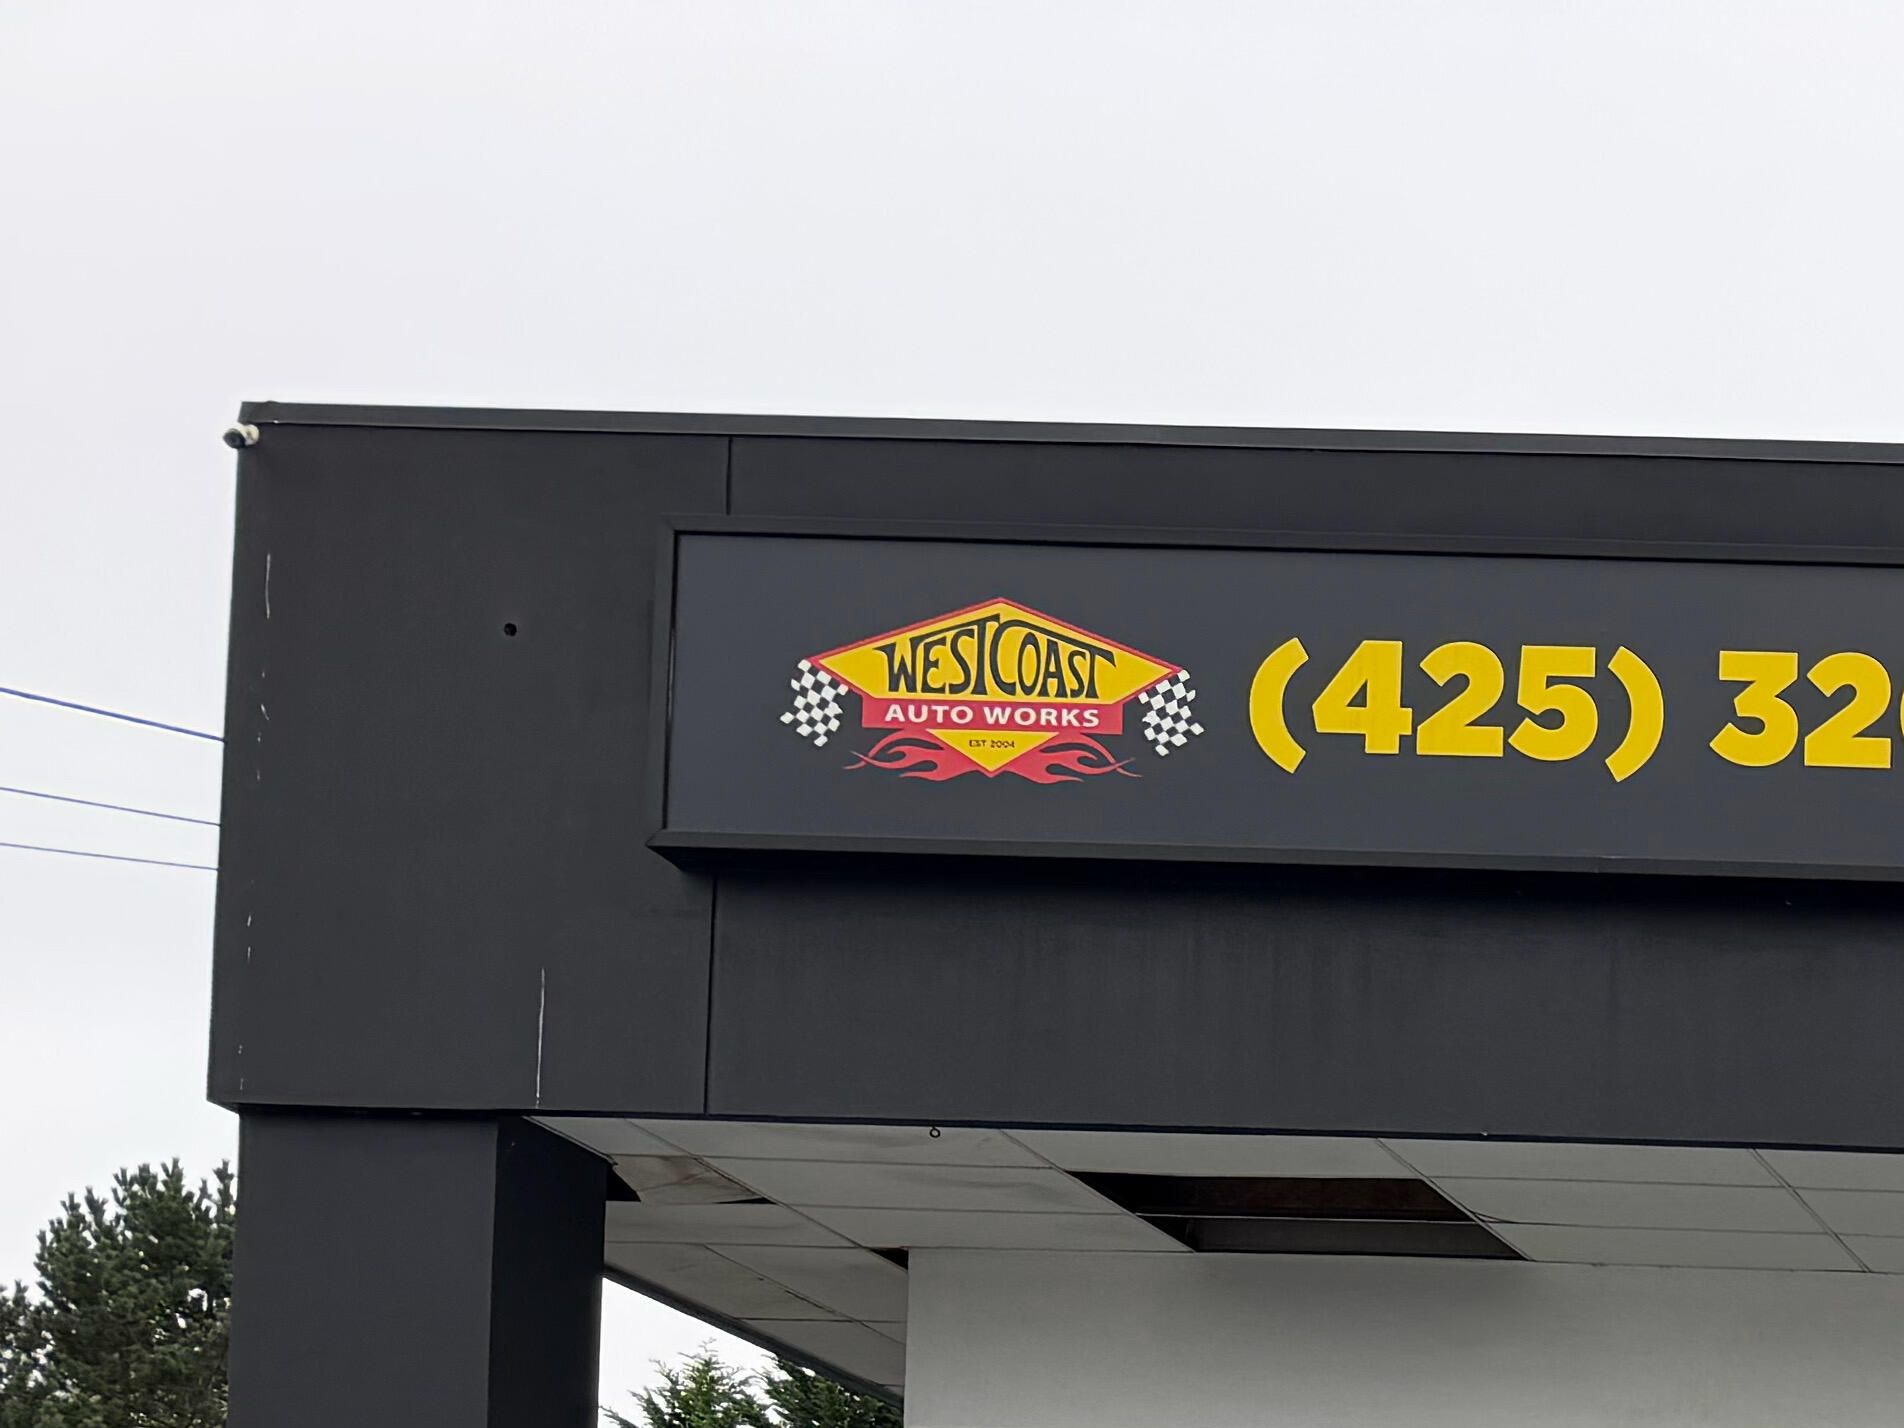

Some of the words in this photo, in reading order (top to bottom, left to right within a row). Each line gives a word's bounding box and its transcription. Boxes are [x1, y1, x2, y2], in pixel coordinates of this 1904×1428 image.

[884, 704, 975, 727] AUTO
[983, 705, 1101, 729] WORKS
[1250, 637, 1665, 782] (425)
